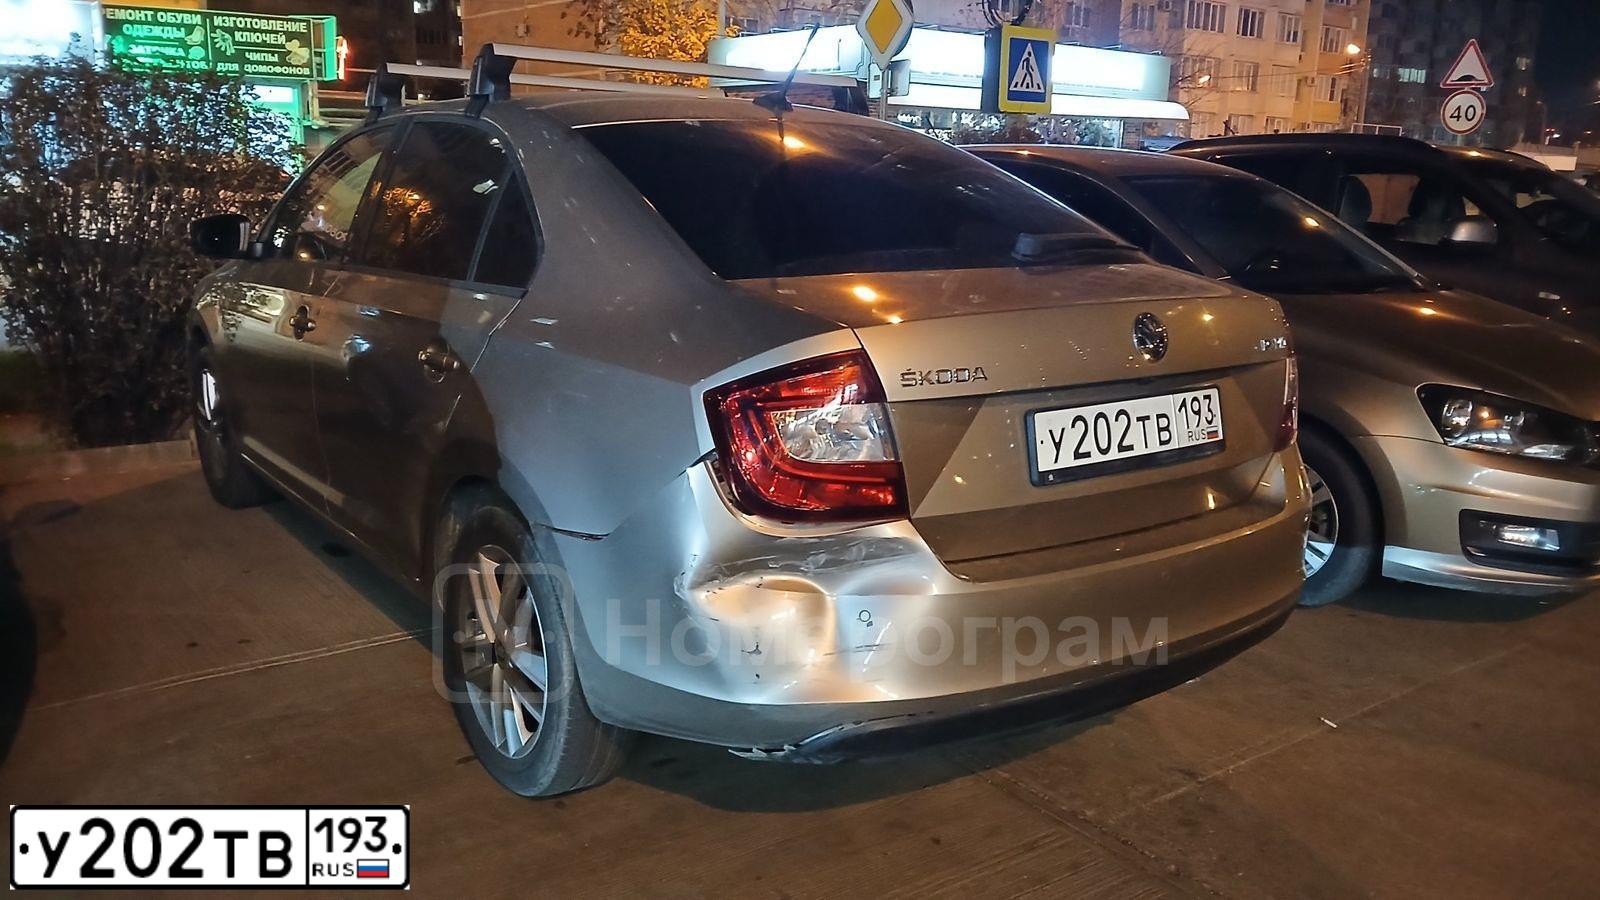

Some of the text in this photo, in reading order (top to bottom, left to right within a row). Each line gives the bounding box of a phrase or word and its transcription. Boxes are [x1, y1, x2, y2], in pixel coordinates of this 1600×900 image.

[102, 7, 202, 25] ЕМОНТ ОБУВИ
[213, 15, 308, 33] ИЗГОТОВЛЕНИЕ
[122, 23, 186, 40] ОДЕЖДЫ
[234, 30, 287, 45] КЛЮЧЕЙ
[245, 51, 279, 63] ЧИПЫ
[1449, 104, 1477, 122] 40
[1177, 394, 1215, 430] 193
[1187, 428, 1207, 443] RUS
